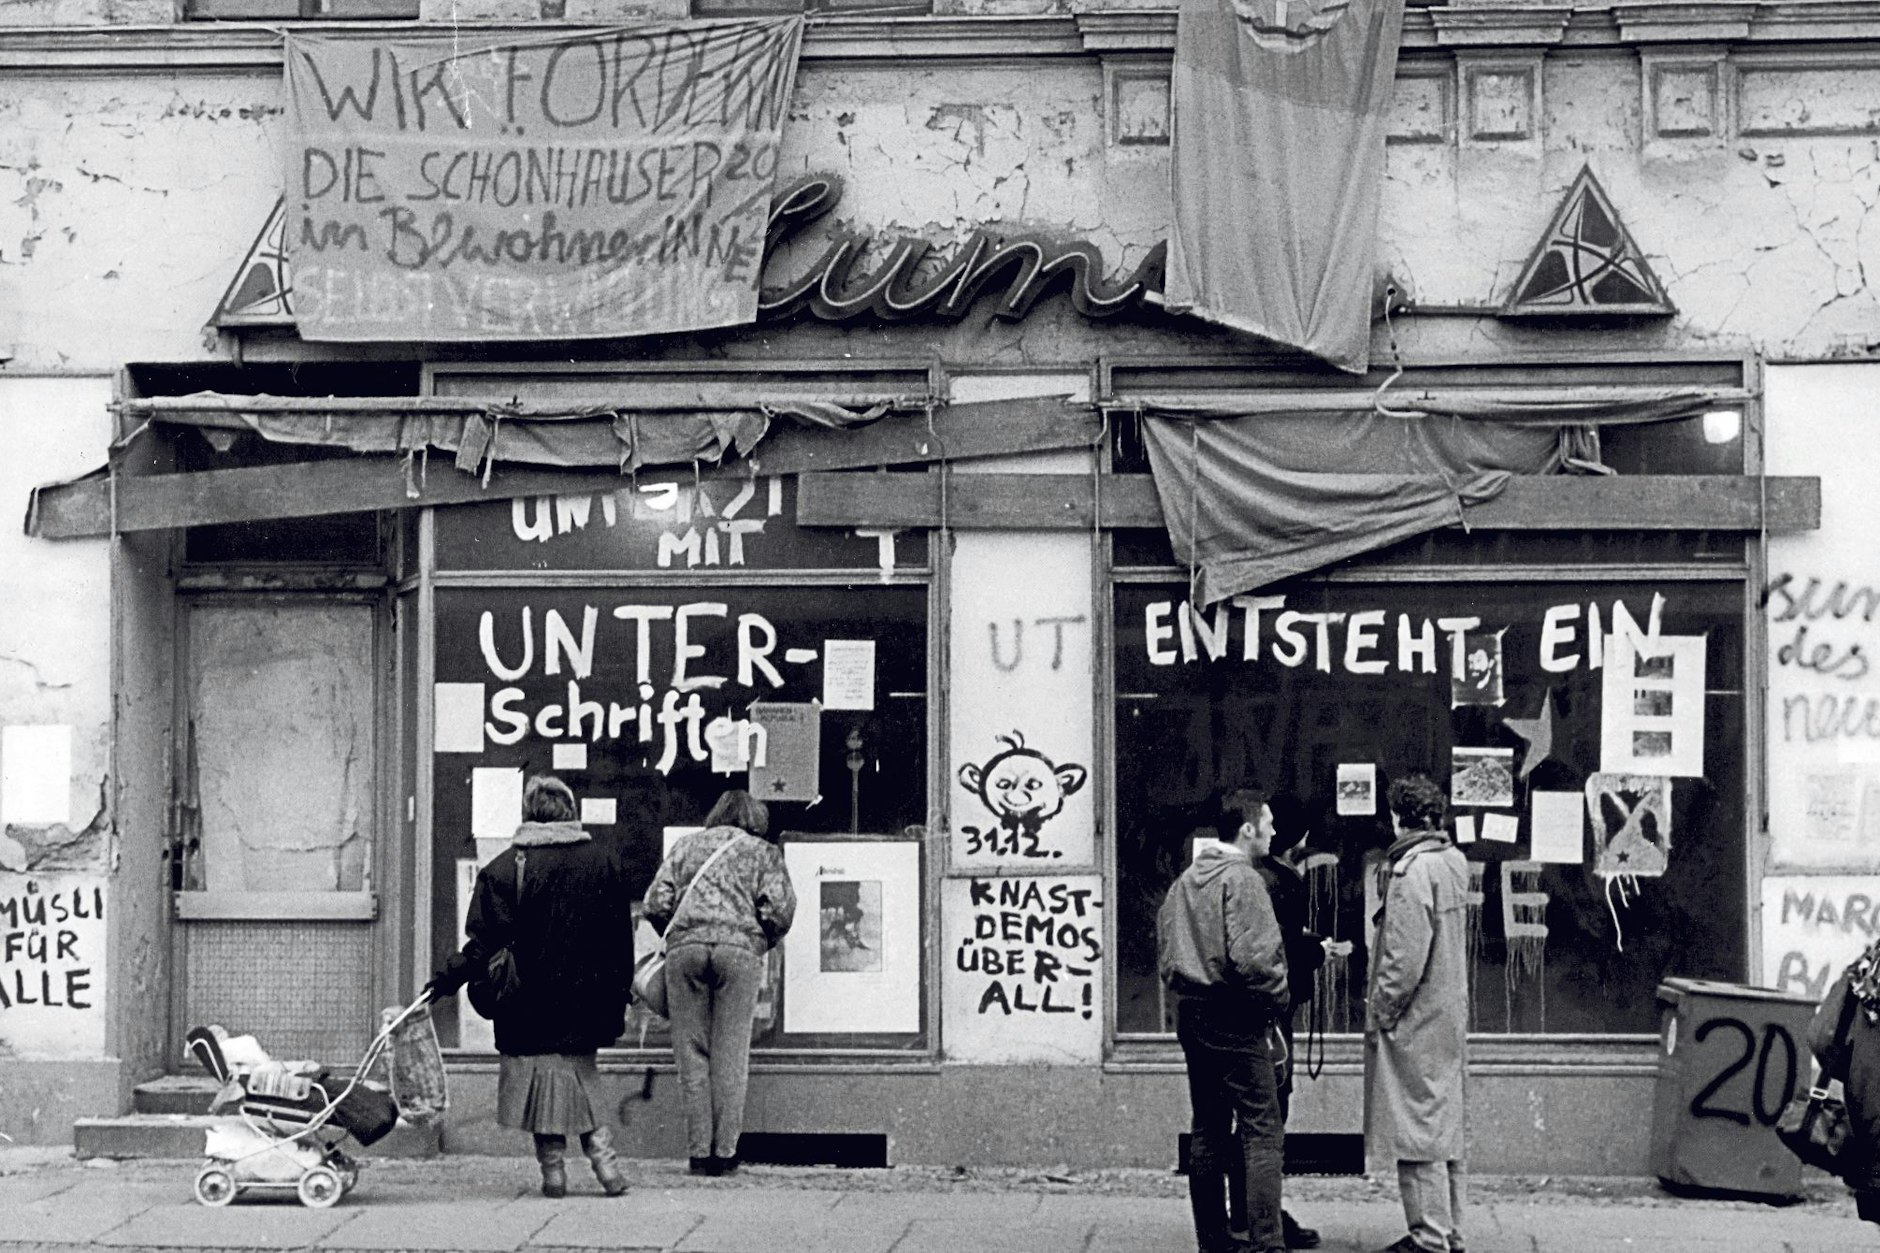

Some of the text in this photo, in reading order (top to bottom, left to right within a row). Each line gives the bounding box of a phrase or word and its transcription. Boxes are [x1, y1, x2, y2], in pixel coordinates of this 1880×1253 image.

[302, 46, 473, 131] WIR
[303, 147, 386, 202] DIE
[725, 143, 777, 181] 20
[657, 519, 767, 567] MIT
[479, 602, 819, 690] UNTER-
[1145, 595, 1481, 682] ENTSTEHT
[1540, 592, 1666, 673] EIN
[1777, 626, 1869, 681] des
[485, 679, 767, 776] Schriften
[969, 879, 1104, 917] KNAST-
[5, 928, 80, 963] FÜR
[957, 938, 1092, 983] ÜBER-
[975, 914, 1101, 962] DEMOS
[978, 982, 1093, 1020] ALL!
[1691, 1017, 1798, 1126] 20
